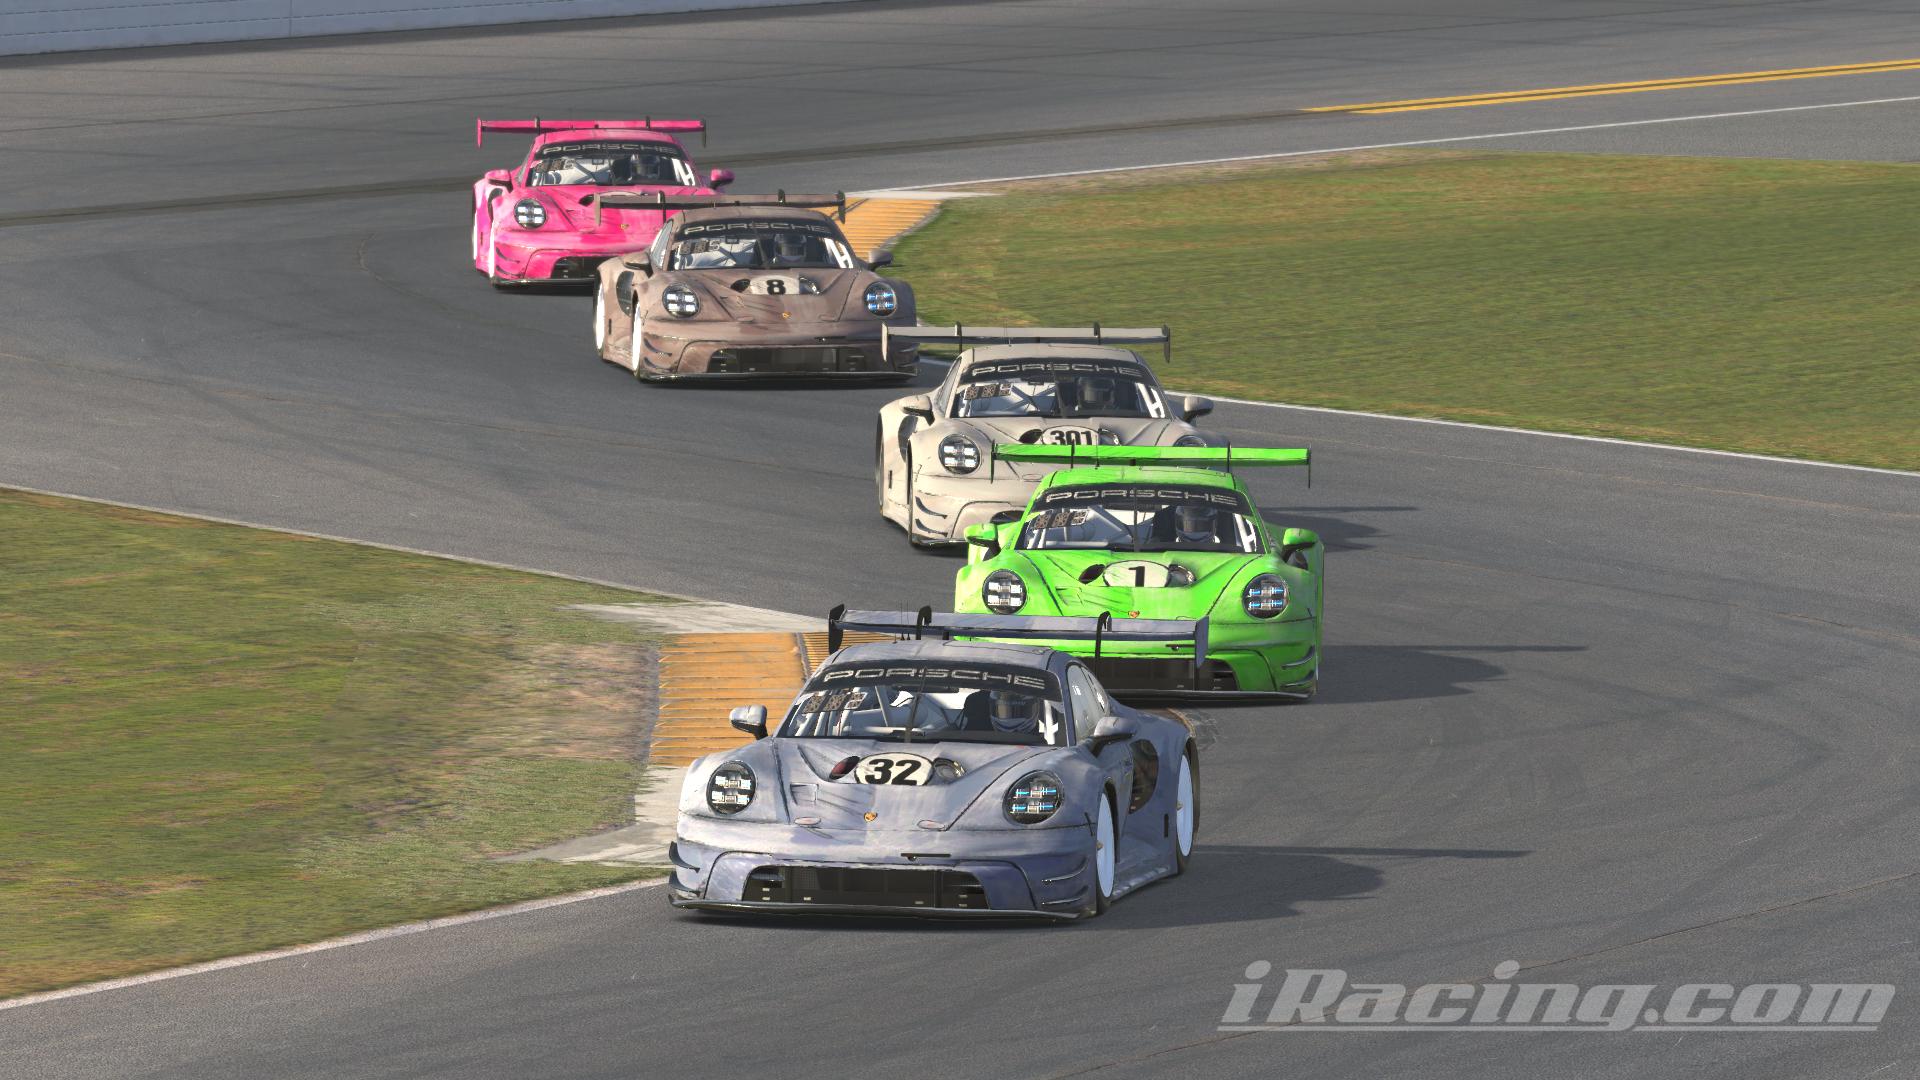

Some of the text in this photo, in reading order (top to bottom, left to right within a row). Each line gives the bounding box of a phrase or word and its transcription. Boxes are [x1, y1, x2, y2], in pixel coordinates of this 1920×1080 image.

[543, 143, 676, 154] PORSCHE
[683, 222, 831, 235] PORSCHE
[766, 279, 786, 295] 8
[972, 364, 1142, 377] PORSCHE
[1050, 430, 1092, 446] 301
[1046, 490, 1238, 506] PORSCHE
[1127, 565, 1146, 588] 1
[824, 669, 1046, 689] PORSCHE
[864, 758, 922, 786] 32
